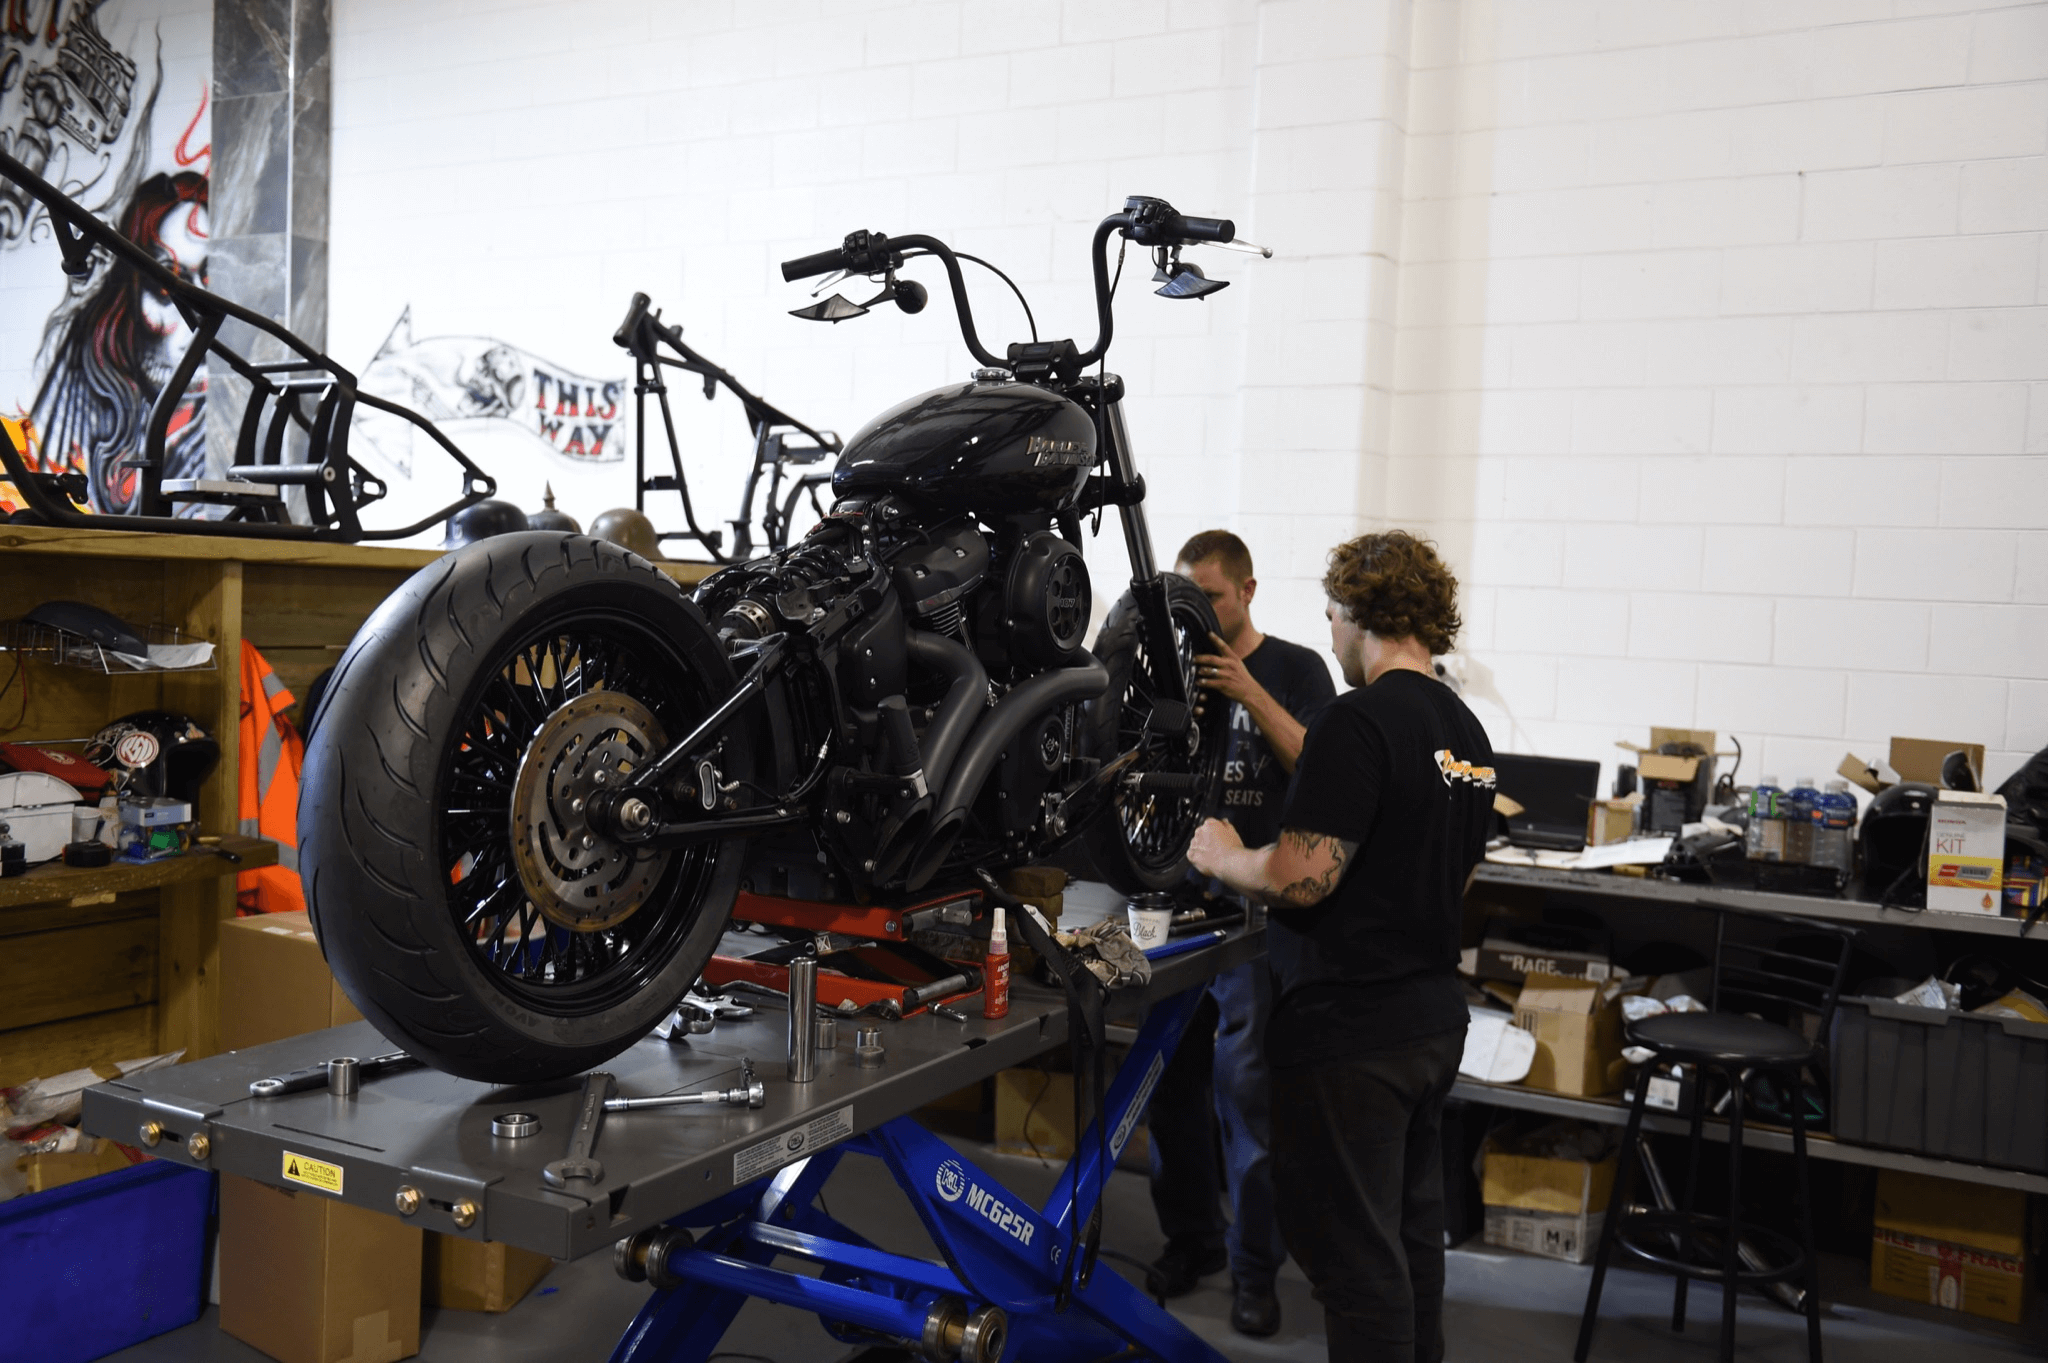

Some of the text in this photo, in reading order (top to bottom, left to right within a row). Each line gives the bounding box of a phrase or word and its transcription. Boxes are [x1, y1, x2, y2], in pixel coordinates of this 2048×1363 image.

[533, 368, 619, 420] THIS
[539, 412, 613, 456] WAY
[1060, 597, 1076, 608] 107
[1224, 789, 1264, 806] SEATS
[1936, 837, 1966, 854] KIT
[1133, 921, 1158, 941] Black
[1512, 954, 1557, 976] RAGE
[303, 1161, 336, 1178] CAUTION
[965, 1182, 1035, 1246] MC625R
[1546, 1229, 1560, 1244] M
